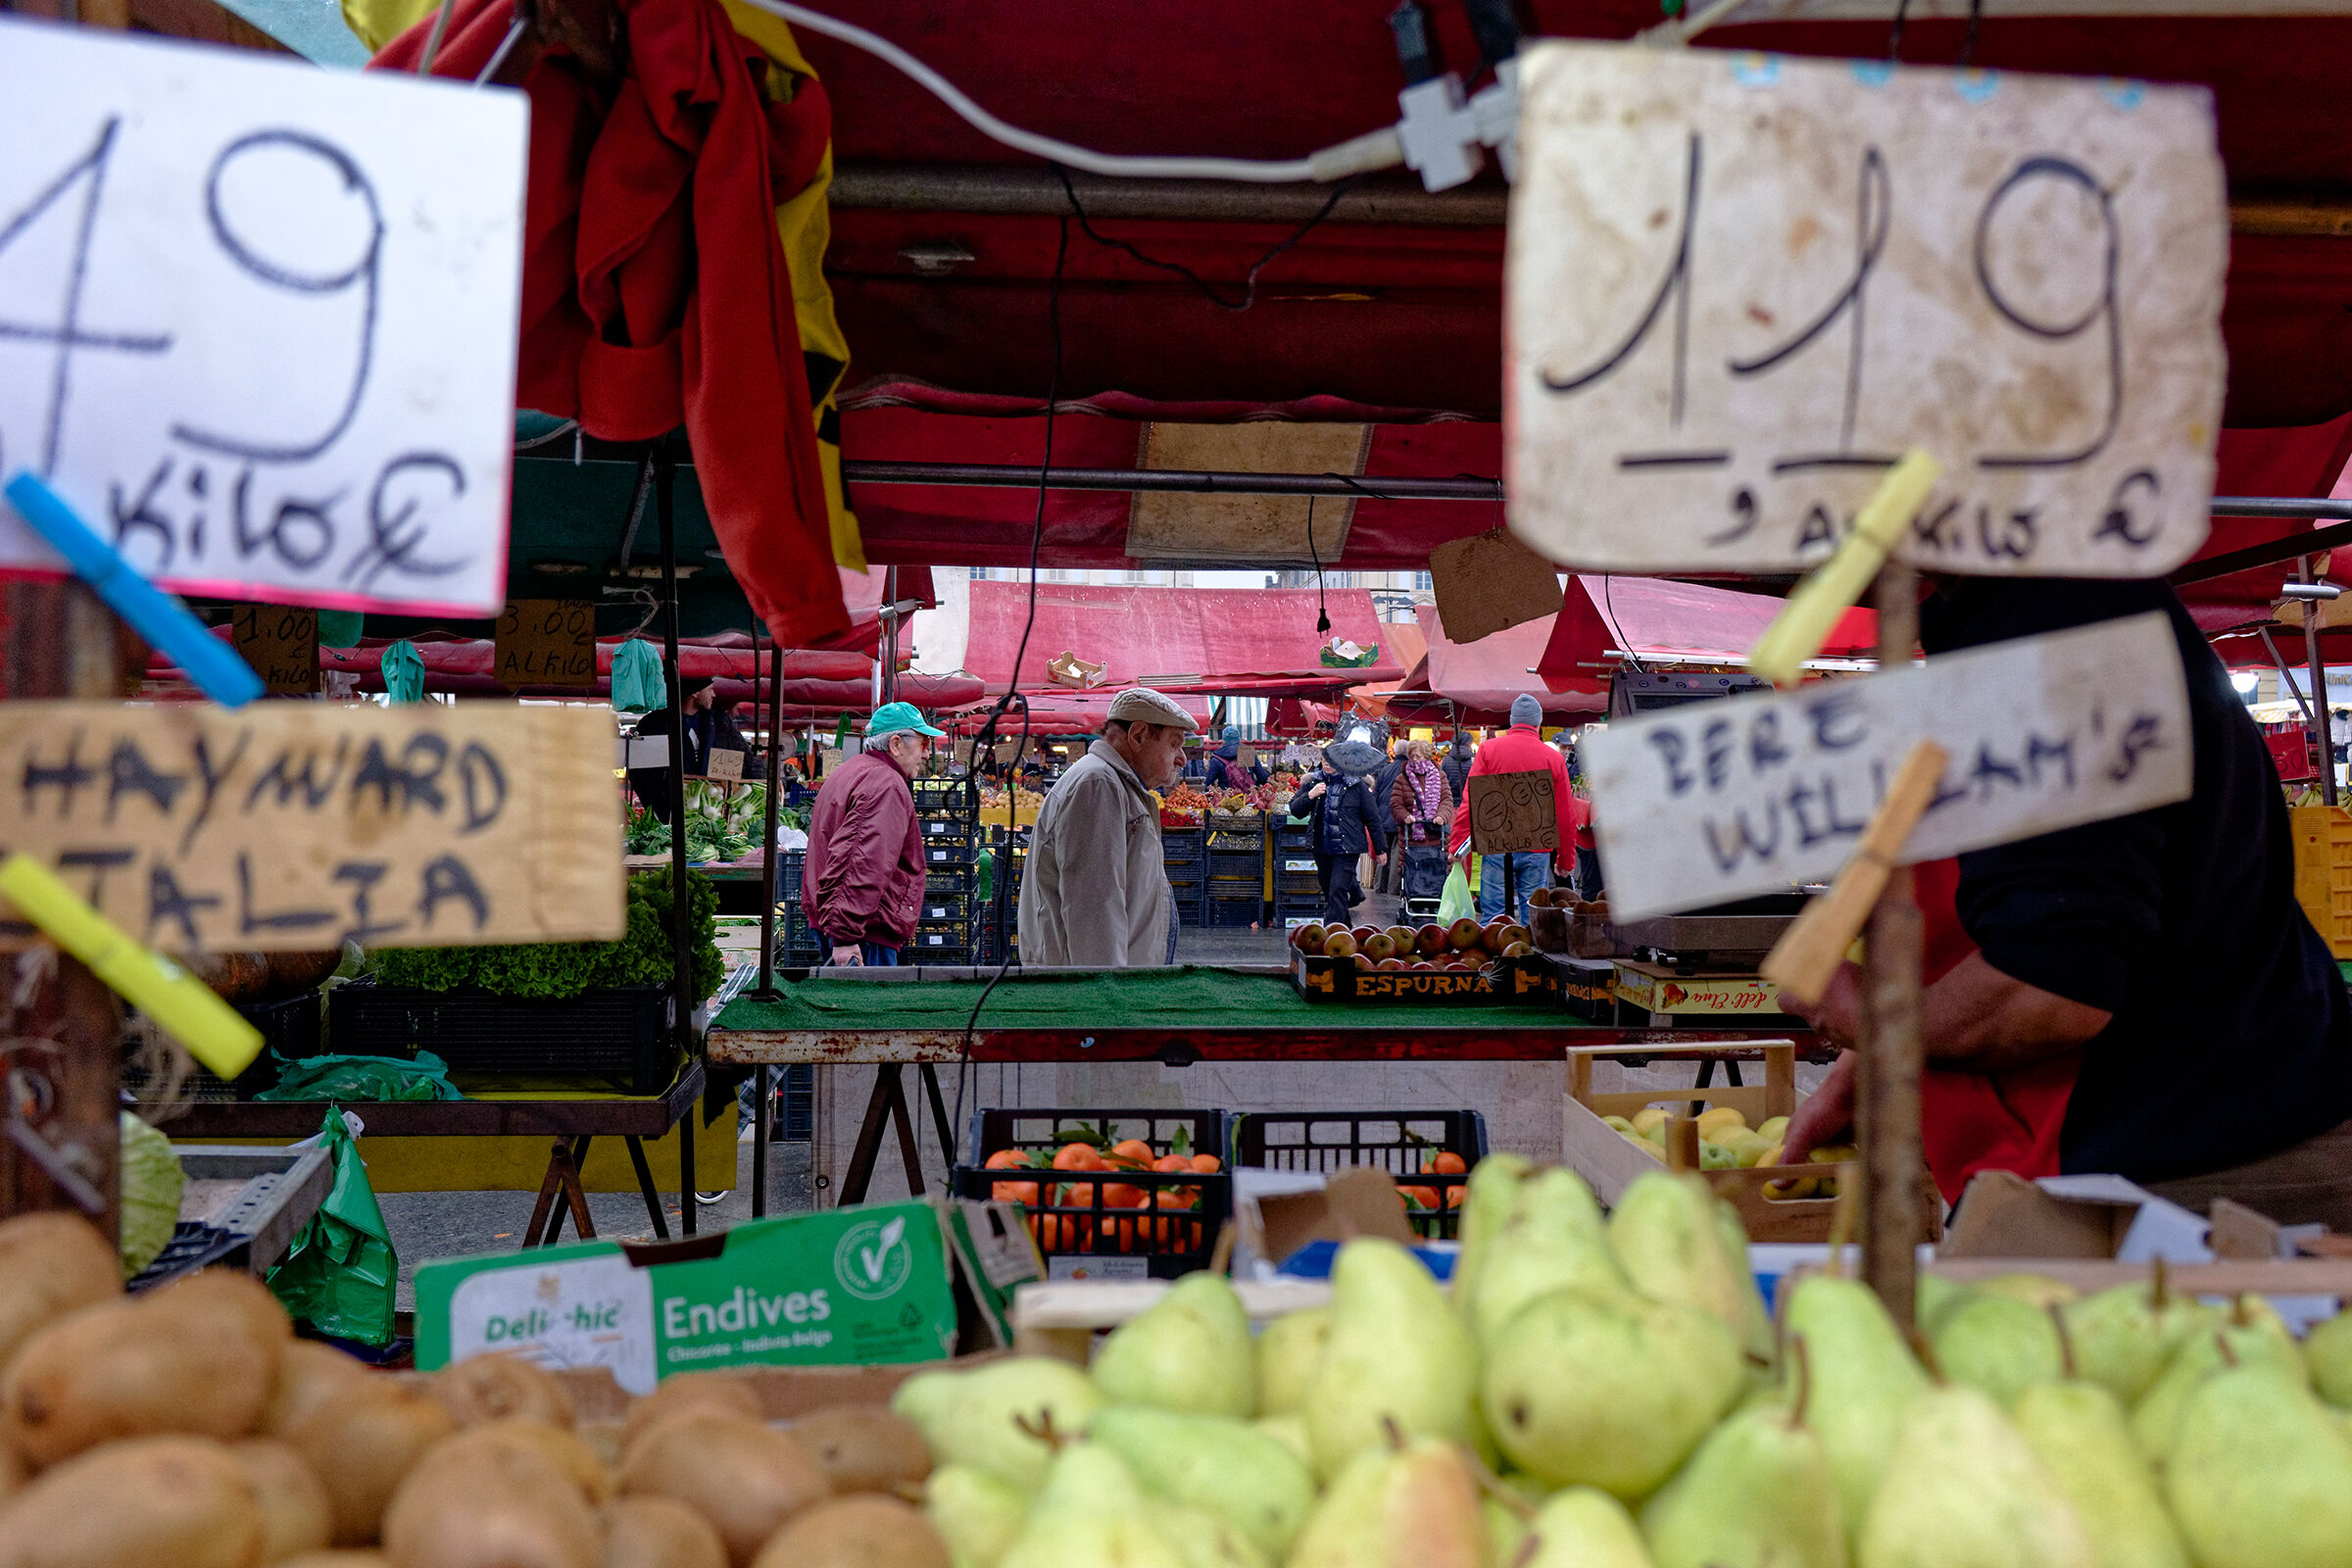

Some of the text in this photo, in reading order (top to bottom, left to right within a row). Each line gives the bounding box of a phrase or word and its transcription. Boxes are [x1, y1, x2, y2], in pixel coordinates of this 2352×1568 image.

[20, 729, 510, 858] HAYWARD
[1355, 974, 1494, 997] ESPURNA
[484, 1298, 624, 1345] Delihic
[662, 1285, 832, 1339] Endives
